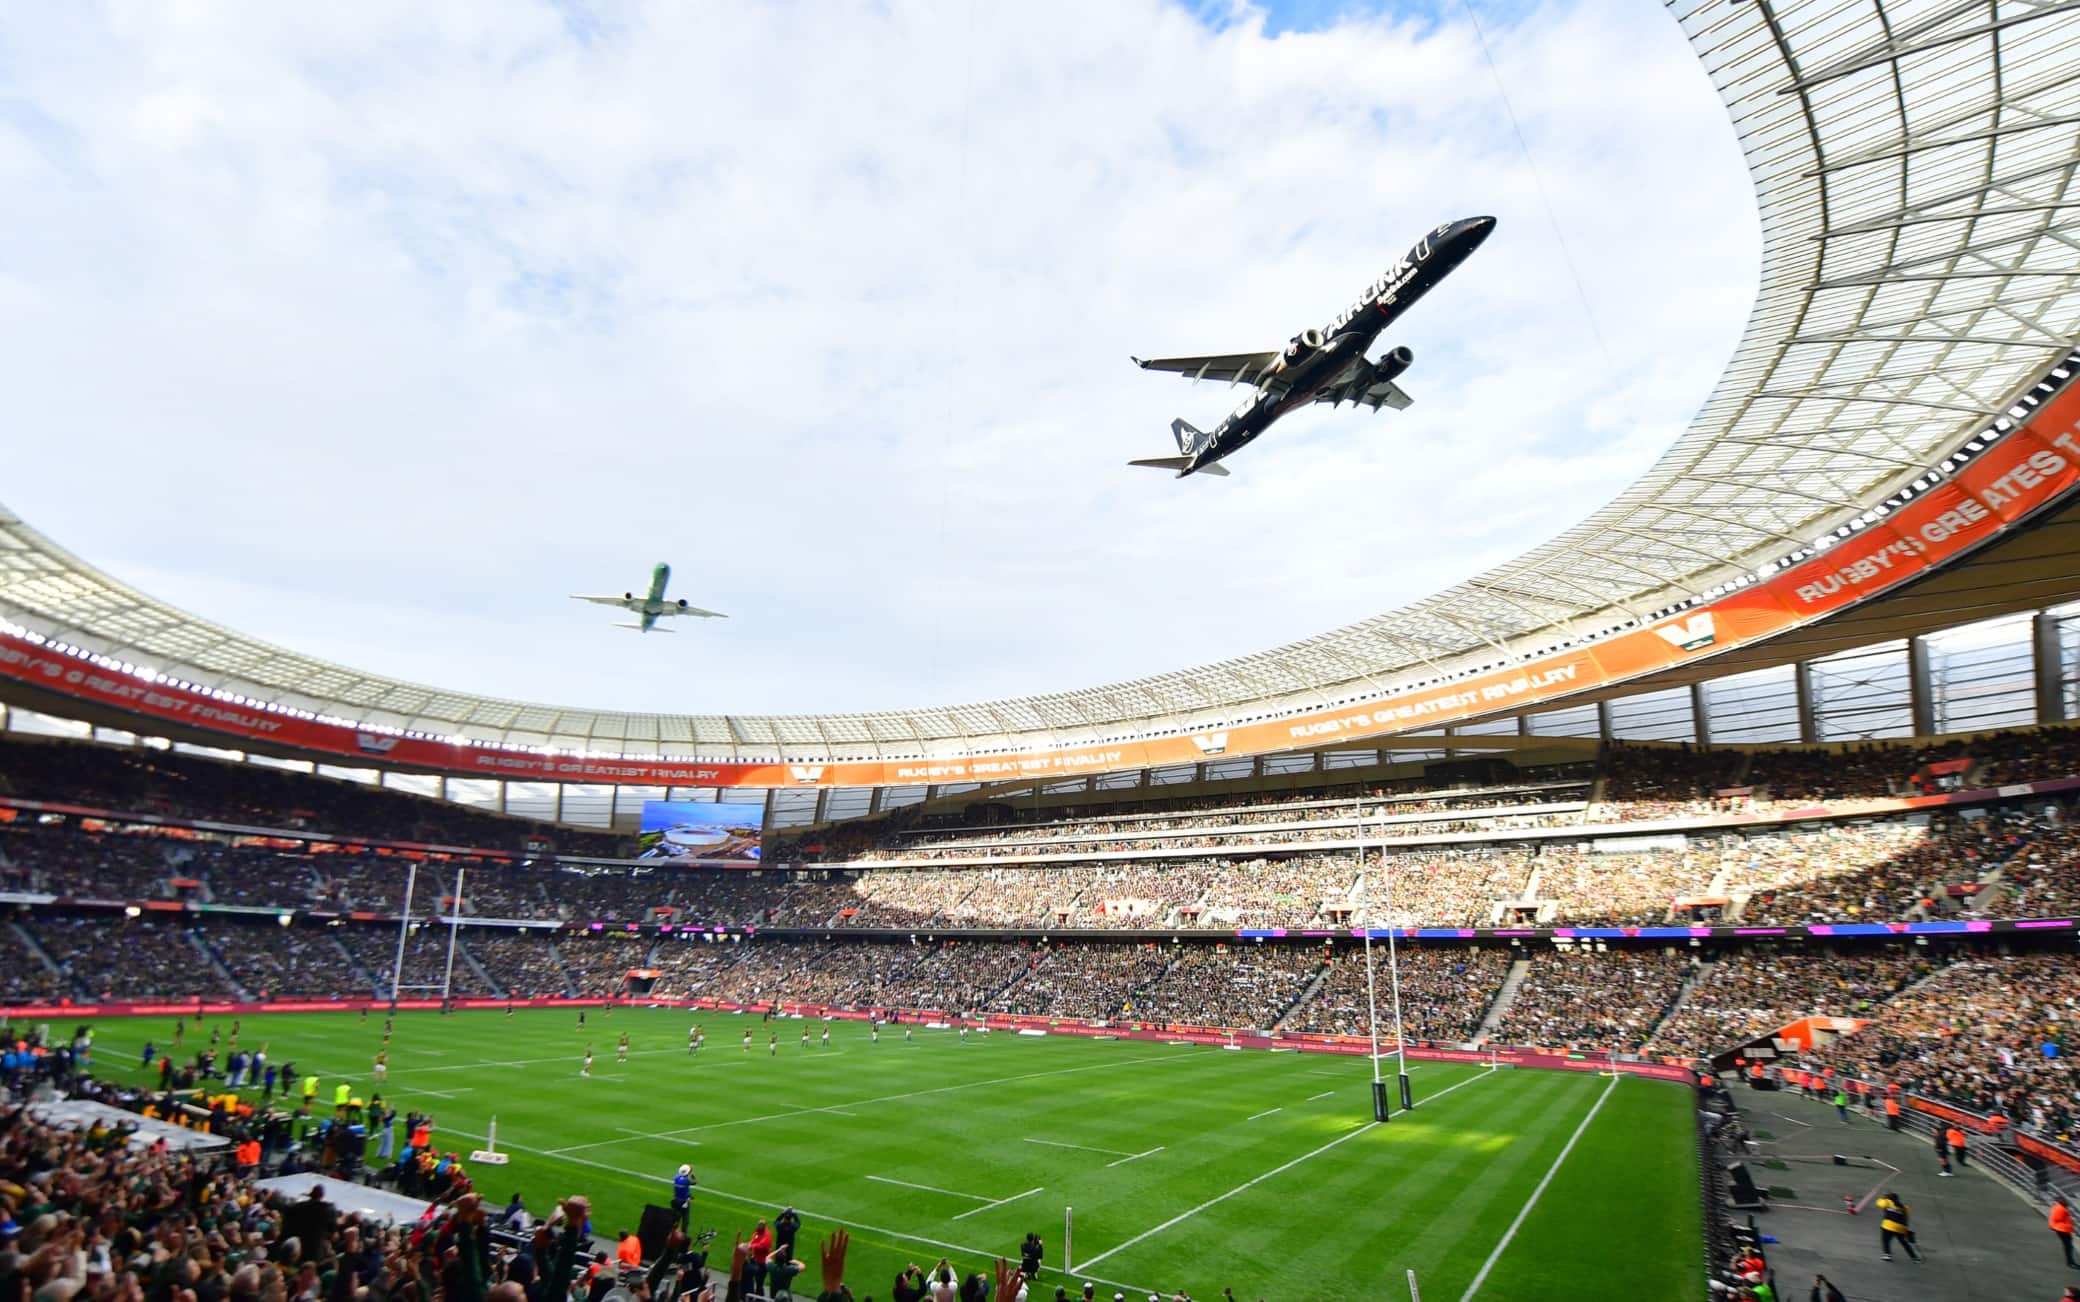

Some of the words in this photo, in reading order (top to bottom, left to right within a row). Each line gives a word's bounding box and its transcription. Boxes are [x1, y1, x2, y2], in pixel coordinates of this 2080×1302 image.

[1324, 255, 1413, 340] AIRLINK
[1289, 713, 1372, 738] RUGBY'S
[1373, 690, 1478, 723] GREATEST
[1481, 664, 1577, 700] RIVALRY
[558, 763, 649, 777] GREATEST
[897, 765, 966, 778] RUGBY'S
